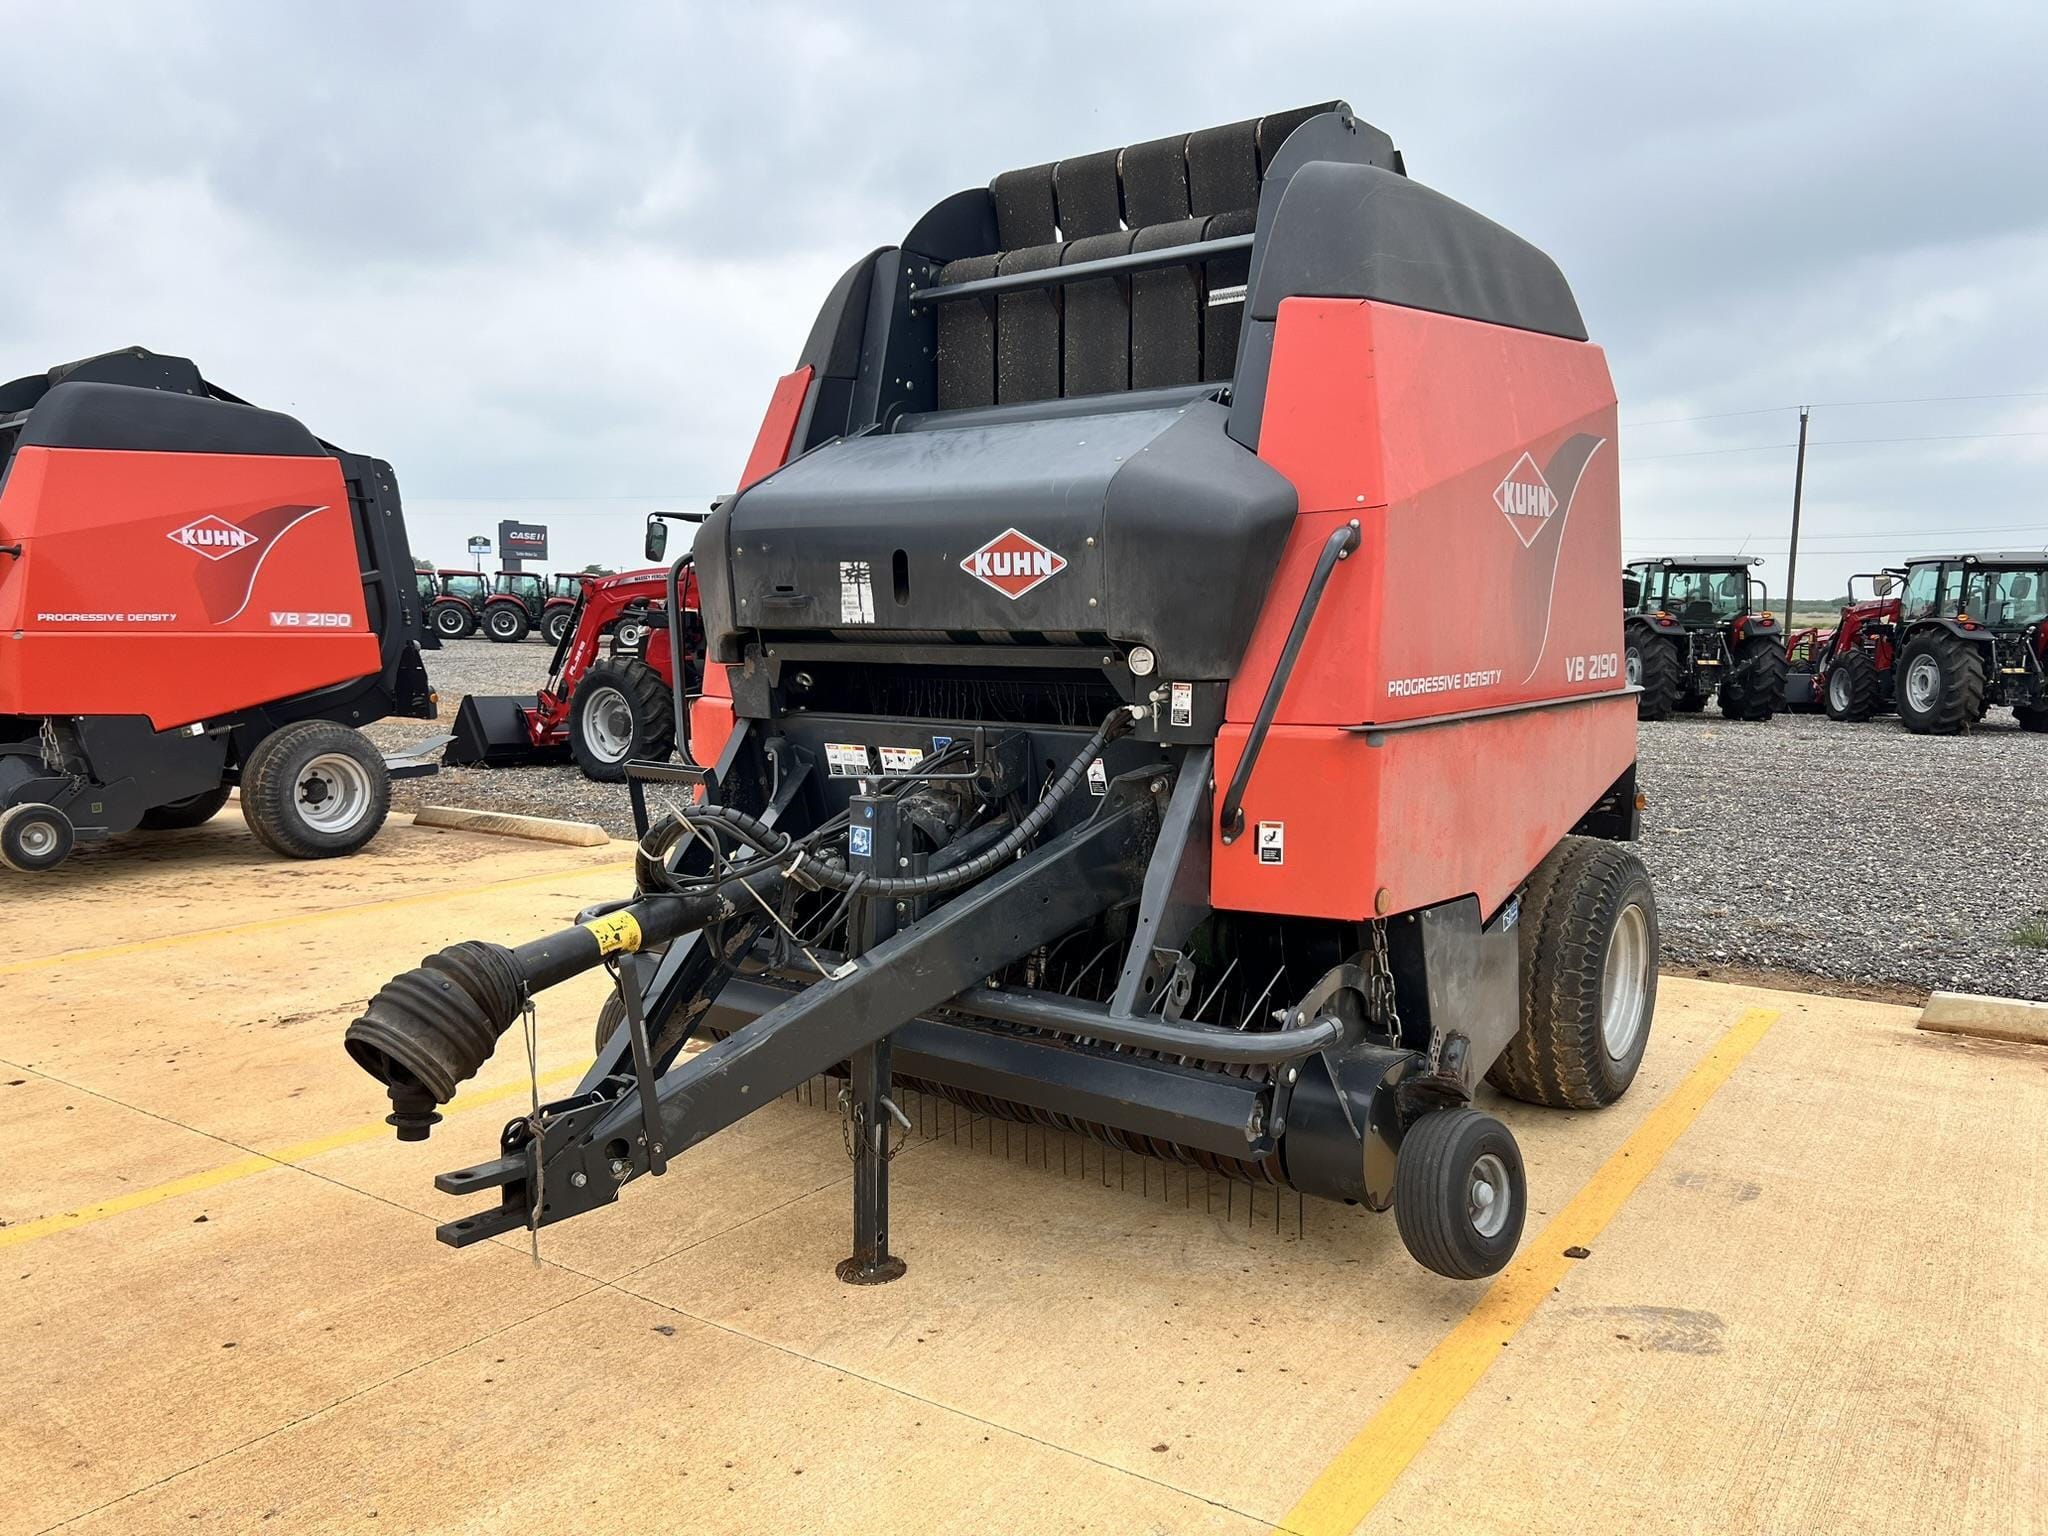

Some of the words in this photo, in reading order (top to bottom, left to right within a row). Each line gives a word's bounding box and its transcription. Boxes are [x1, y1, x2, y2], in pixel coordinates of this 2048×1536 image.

[1503, 481, 1550, 518] KUHN
[181, 529, 246, 546] KUHN
[509, 531, 536, 540] CASE
[974, 551, 1052, 576] KUHN
[37, 613, 124, 622] PROGRESSIVE
[127, 613, 177, 622] DENSITY
[271, 612, 300, 626] VB
[306, 612, 351, 627] 2190
[1565, 656, 1585, 682] VB
[1588, 653, 1618, 679] 2190
[1387, 674, 1461, 698] PROGRESSIVE
[1463, 669, 1502, 689] DENSITY
